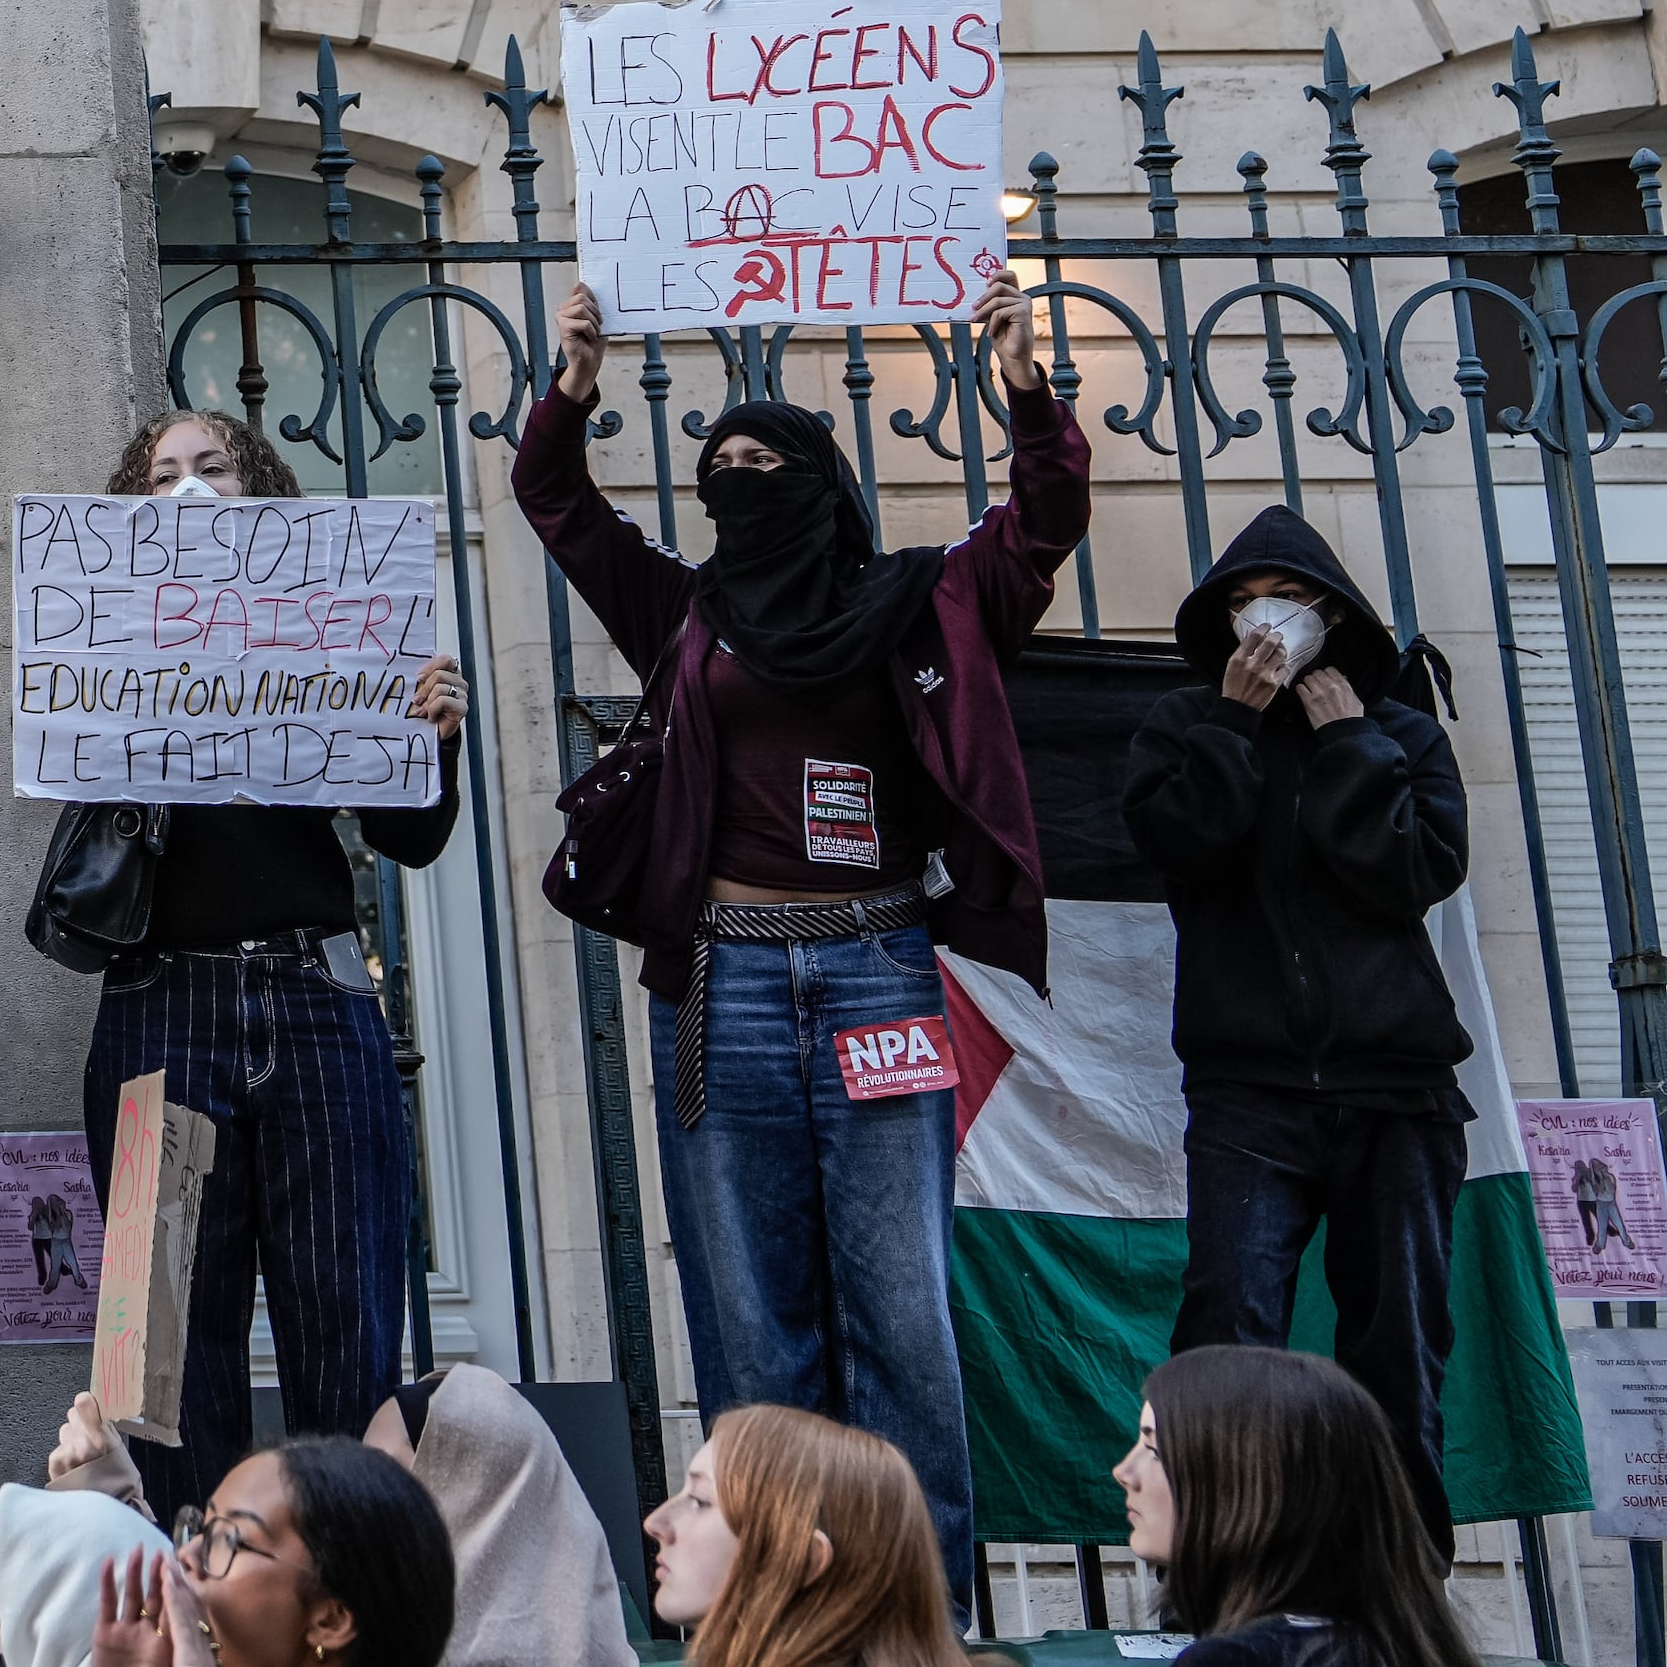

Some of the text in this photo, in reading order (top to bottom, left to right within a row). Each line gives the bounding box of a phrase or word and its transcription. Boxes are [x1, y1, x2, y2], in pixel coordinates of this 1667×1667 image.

[588, 6, 996, 108] LES LYCÉENS
[582, 95, 987, 179] VISENT LE BAC
[590, 183, 980, 242] LA BAC VISE
[616, 224, 965, 314] LES TÊTES
[19, 503, 411, 593] PAS BESOIN
[34, 585, 135, 648] DE
[922, 676, 945, 693] adidas
[36, 723, 437, 793] LE FAIT DEJA
[813, 780, 866, 793] SOLIDARITÉ
[818, 793, 834, 801] AVEC
[843, 797, 864, 807] PEUPLE
[809, 807, 866, 821] PALESTINIEN
[811, 835, 875, 850] TRAVAILLEURS
[822, 844, 842, 852] TOUS
[843, 845, 855, 853] LES
[812, 851, 872, 863] UNISSONS-NOUS
[846, 1026, 939, 1072] NPA
[857, 1066, 944, 1088] RÉVOLUTIONNAIRES
[1579, 1117, 1598, 1128] nos
[1603, 1114, 1630, 1130] idées
[40, 1150, 60, 1162] nos
[1604, 1143, 1633, 1158] Sasha
[64, 1177, 92, 1193] Sasha
[1556, 1270, 1657, 1287] Votez pour nous
[3, 1308, 73, 1328] Votez pour
